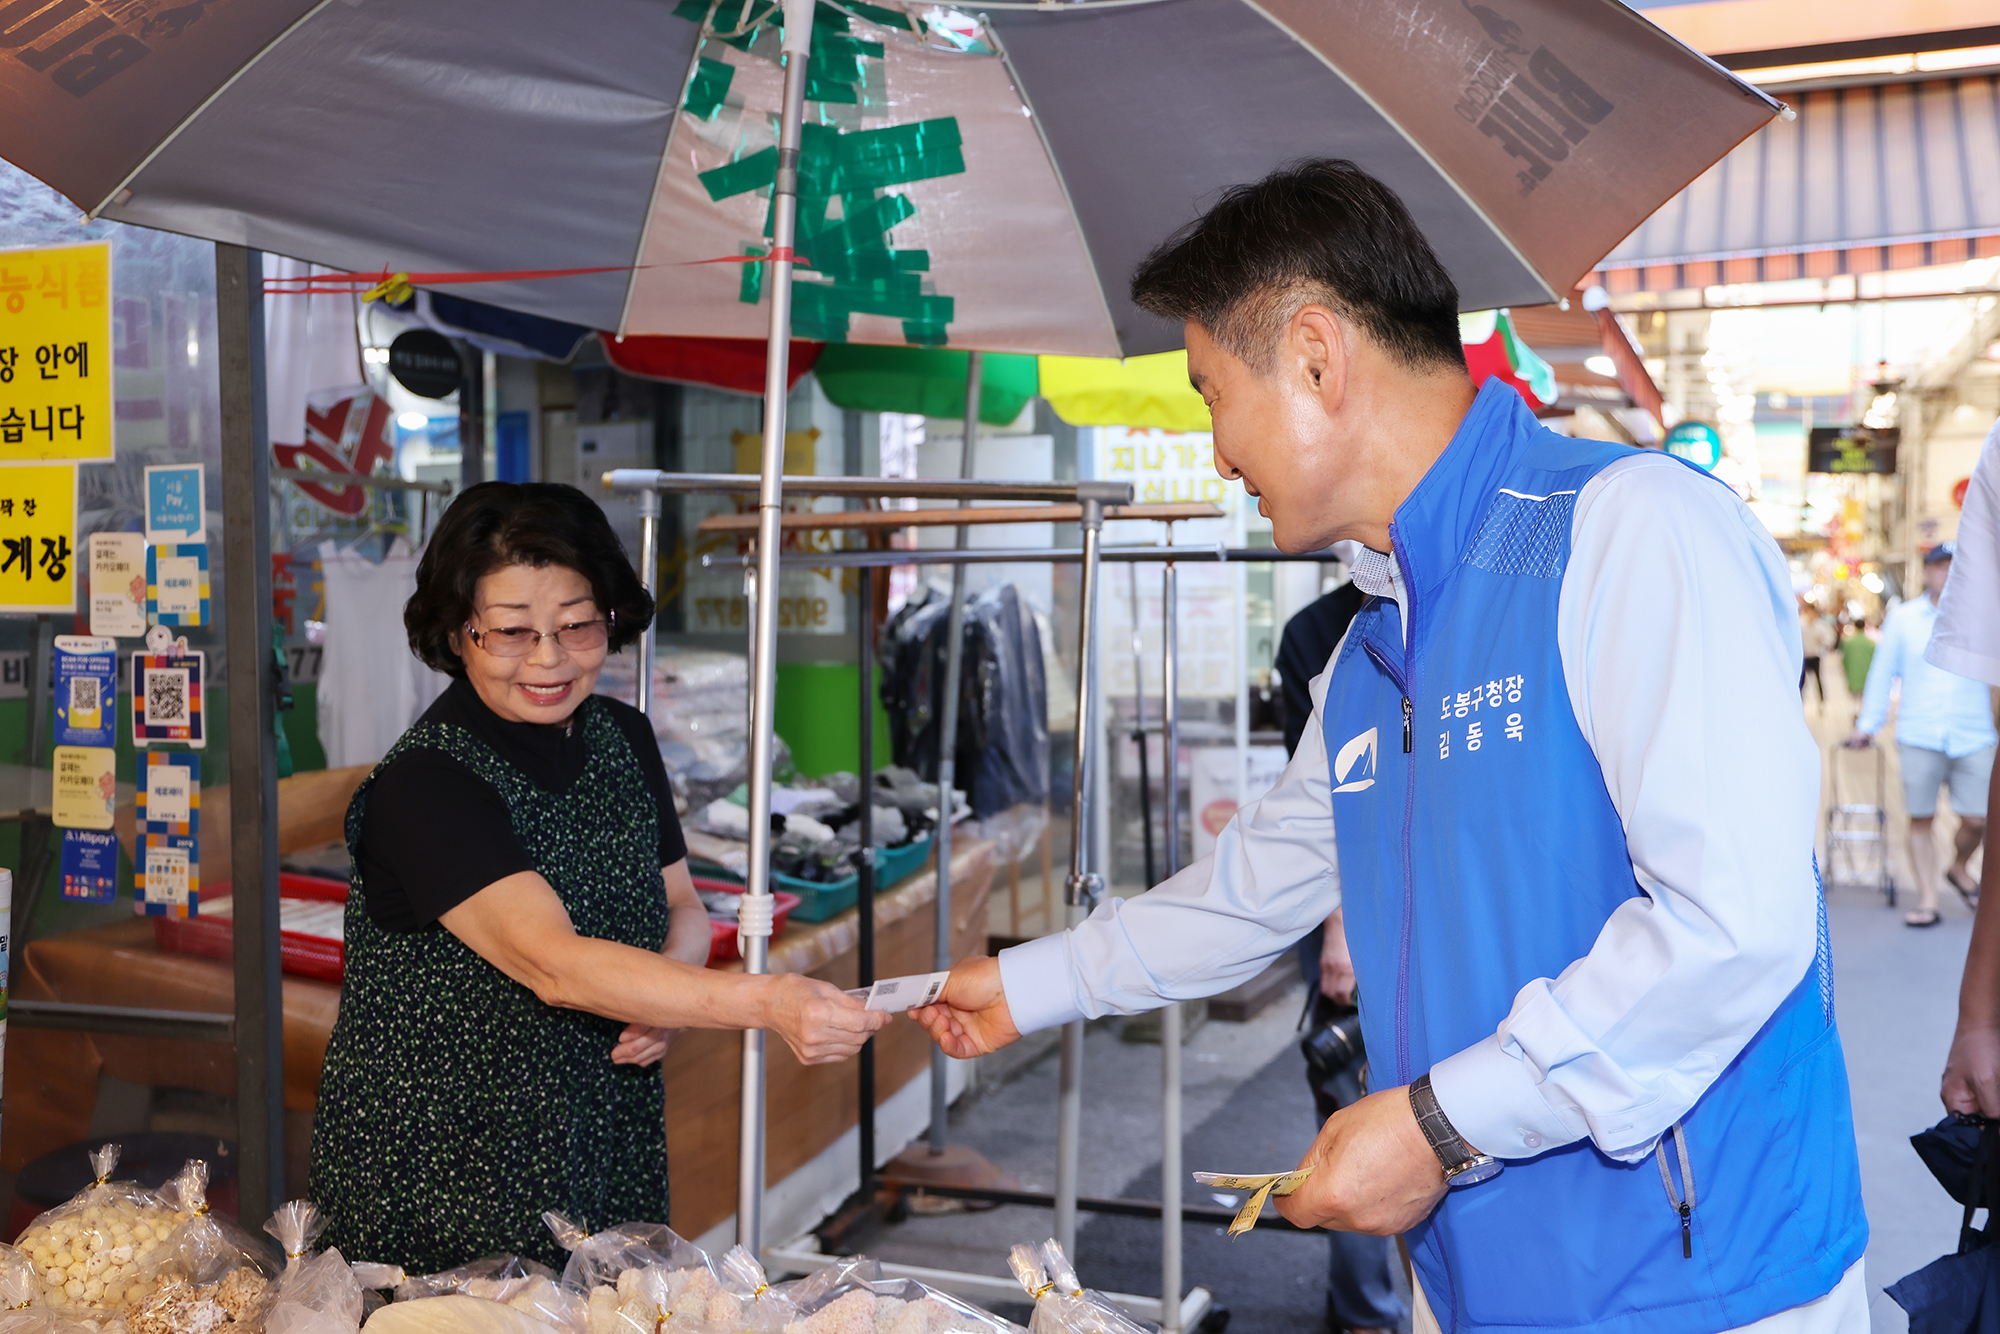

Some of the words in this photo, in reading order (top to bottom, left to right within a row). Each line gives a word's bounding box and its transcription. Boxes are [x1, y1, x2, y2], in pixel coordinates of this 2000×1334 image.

[35, 341, 88, 380] 안에
[0, 403, 85, 443] 습니다
[166, 493, 184, 508] Pay
[1, 535, 72, 582] 게장
[1440, 674, 1525, 720] 도봉구청장
